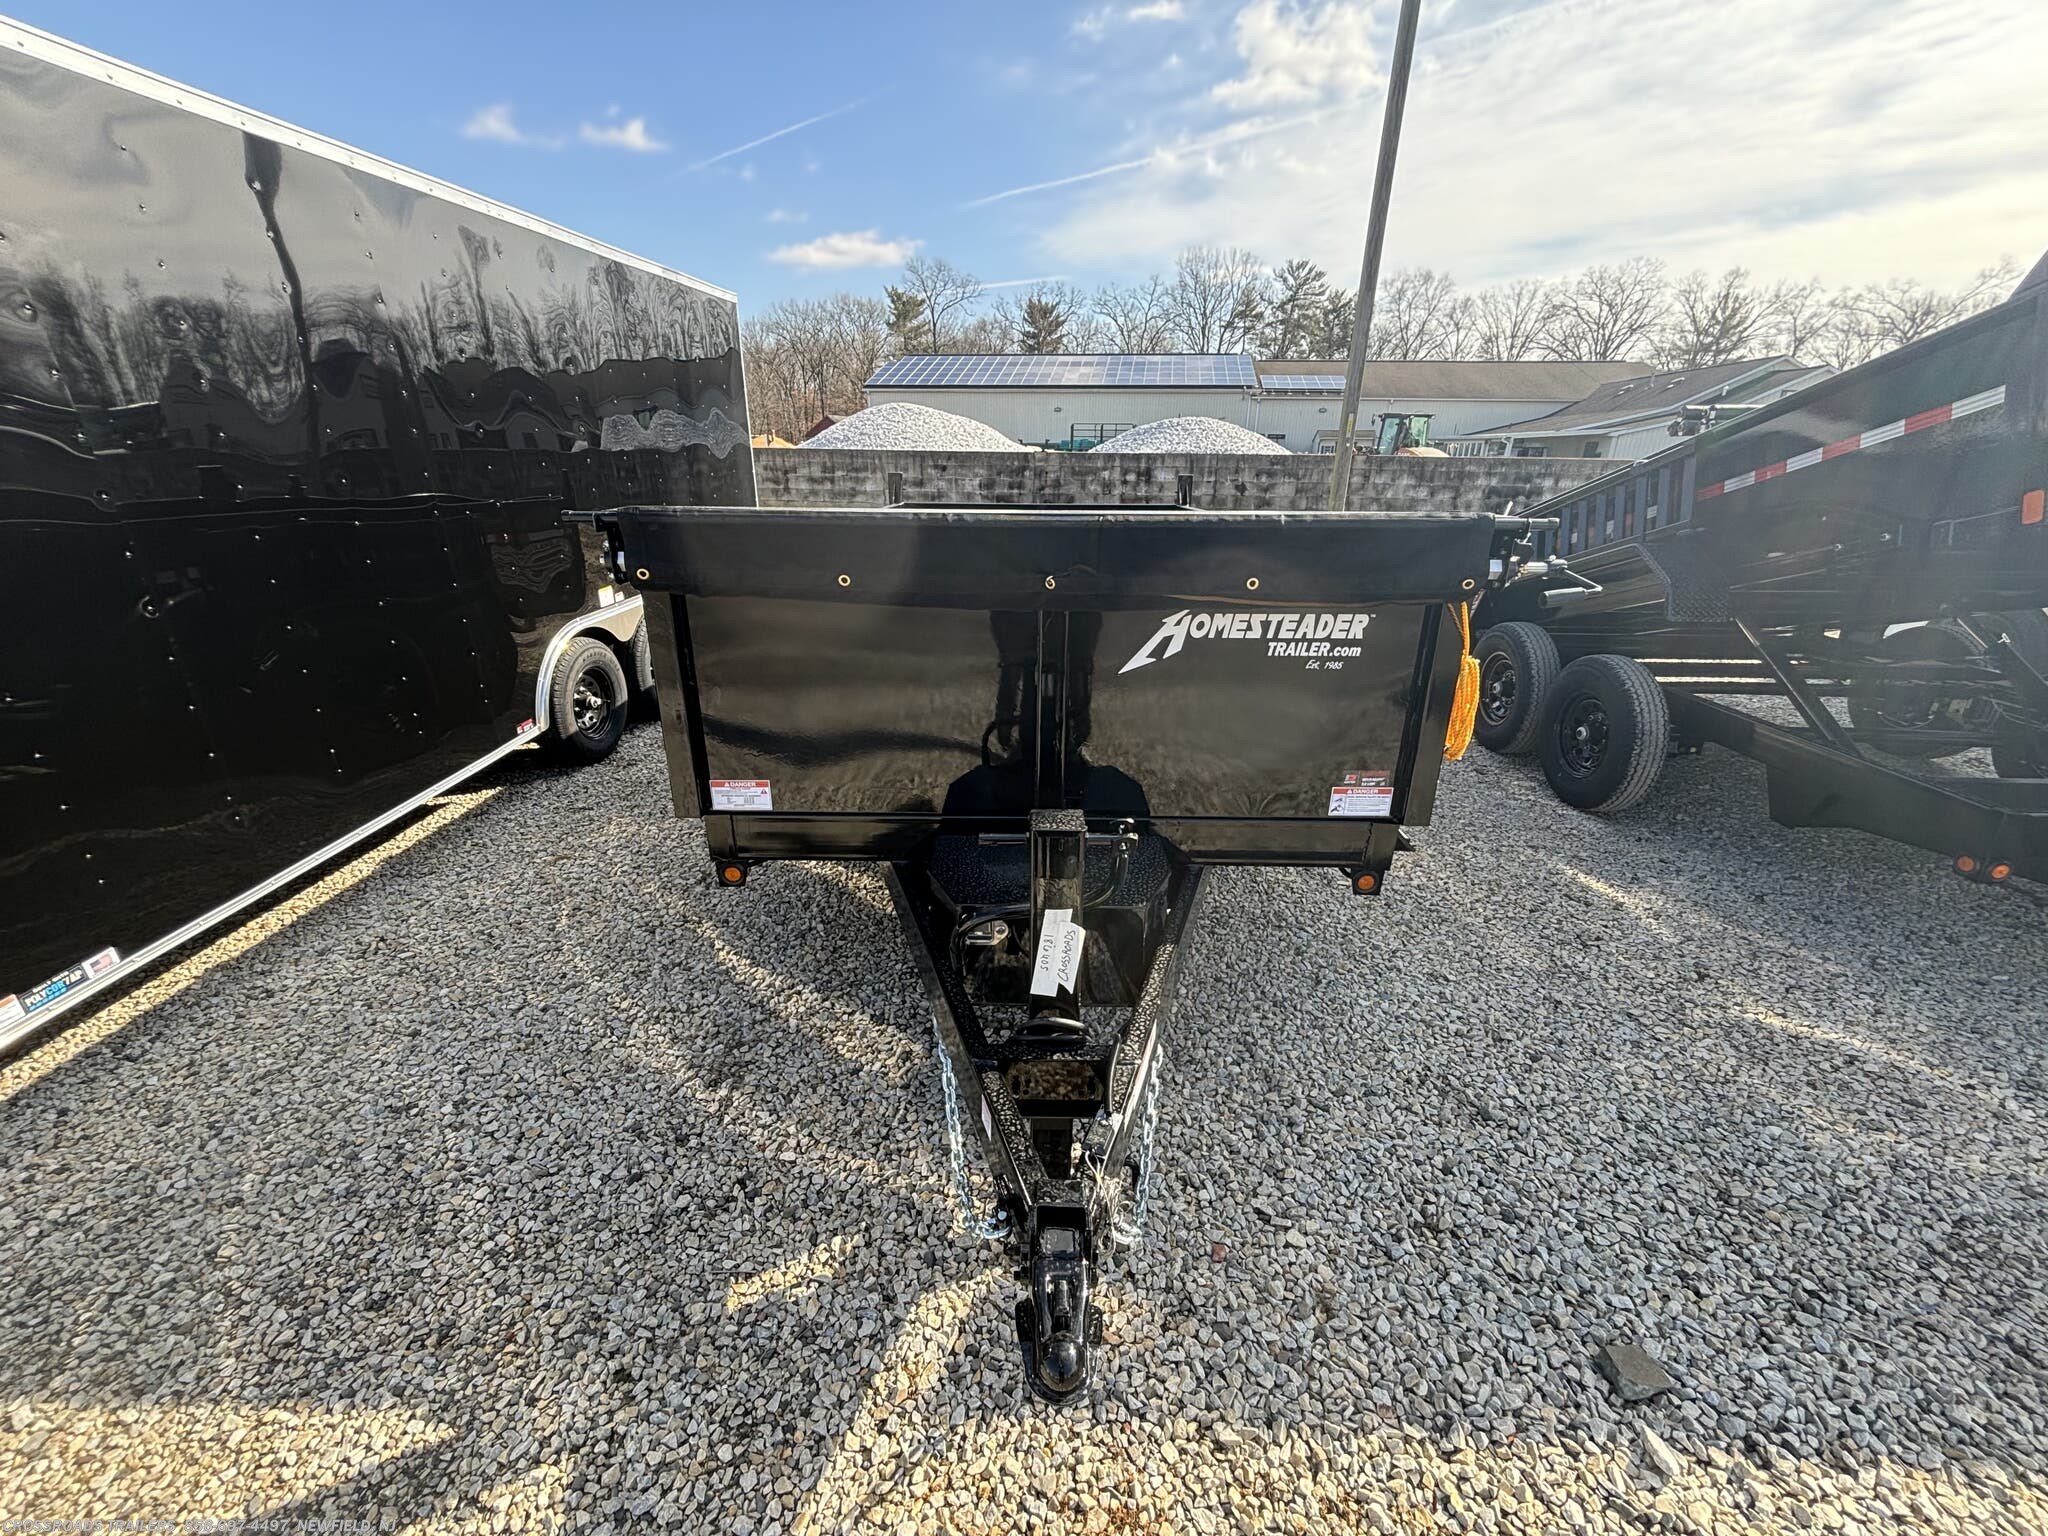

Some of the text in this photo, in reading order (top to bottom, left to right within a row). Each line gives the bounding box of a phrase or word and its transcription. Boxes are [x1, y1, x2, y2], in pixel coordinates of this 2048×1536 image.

[1117, 609, 1370, 675] HOMESTEADER
[1267, 641, 1361, 657] TRAILER.com
[1057, 930, 1076, 982] CROSSROADS
